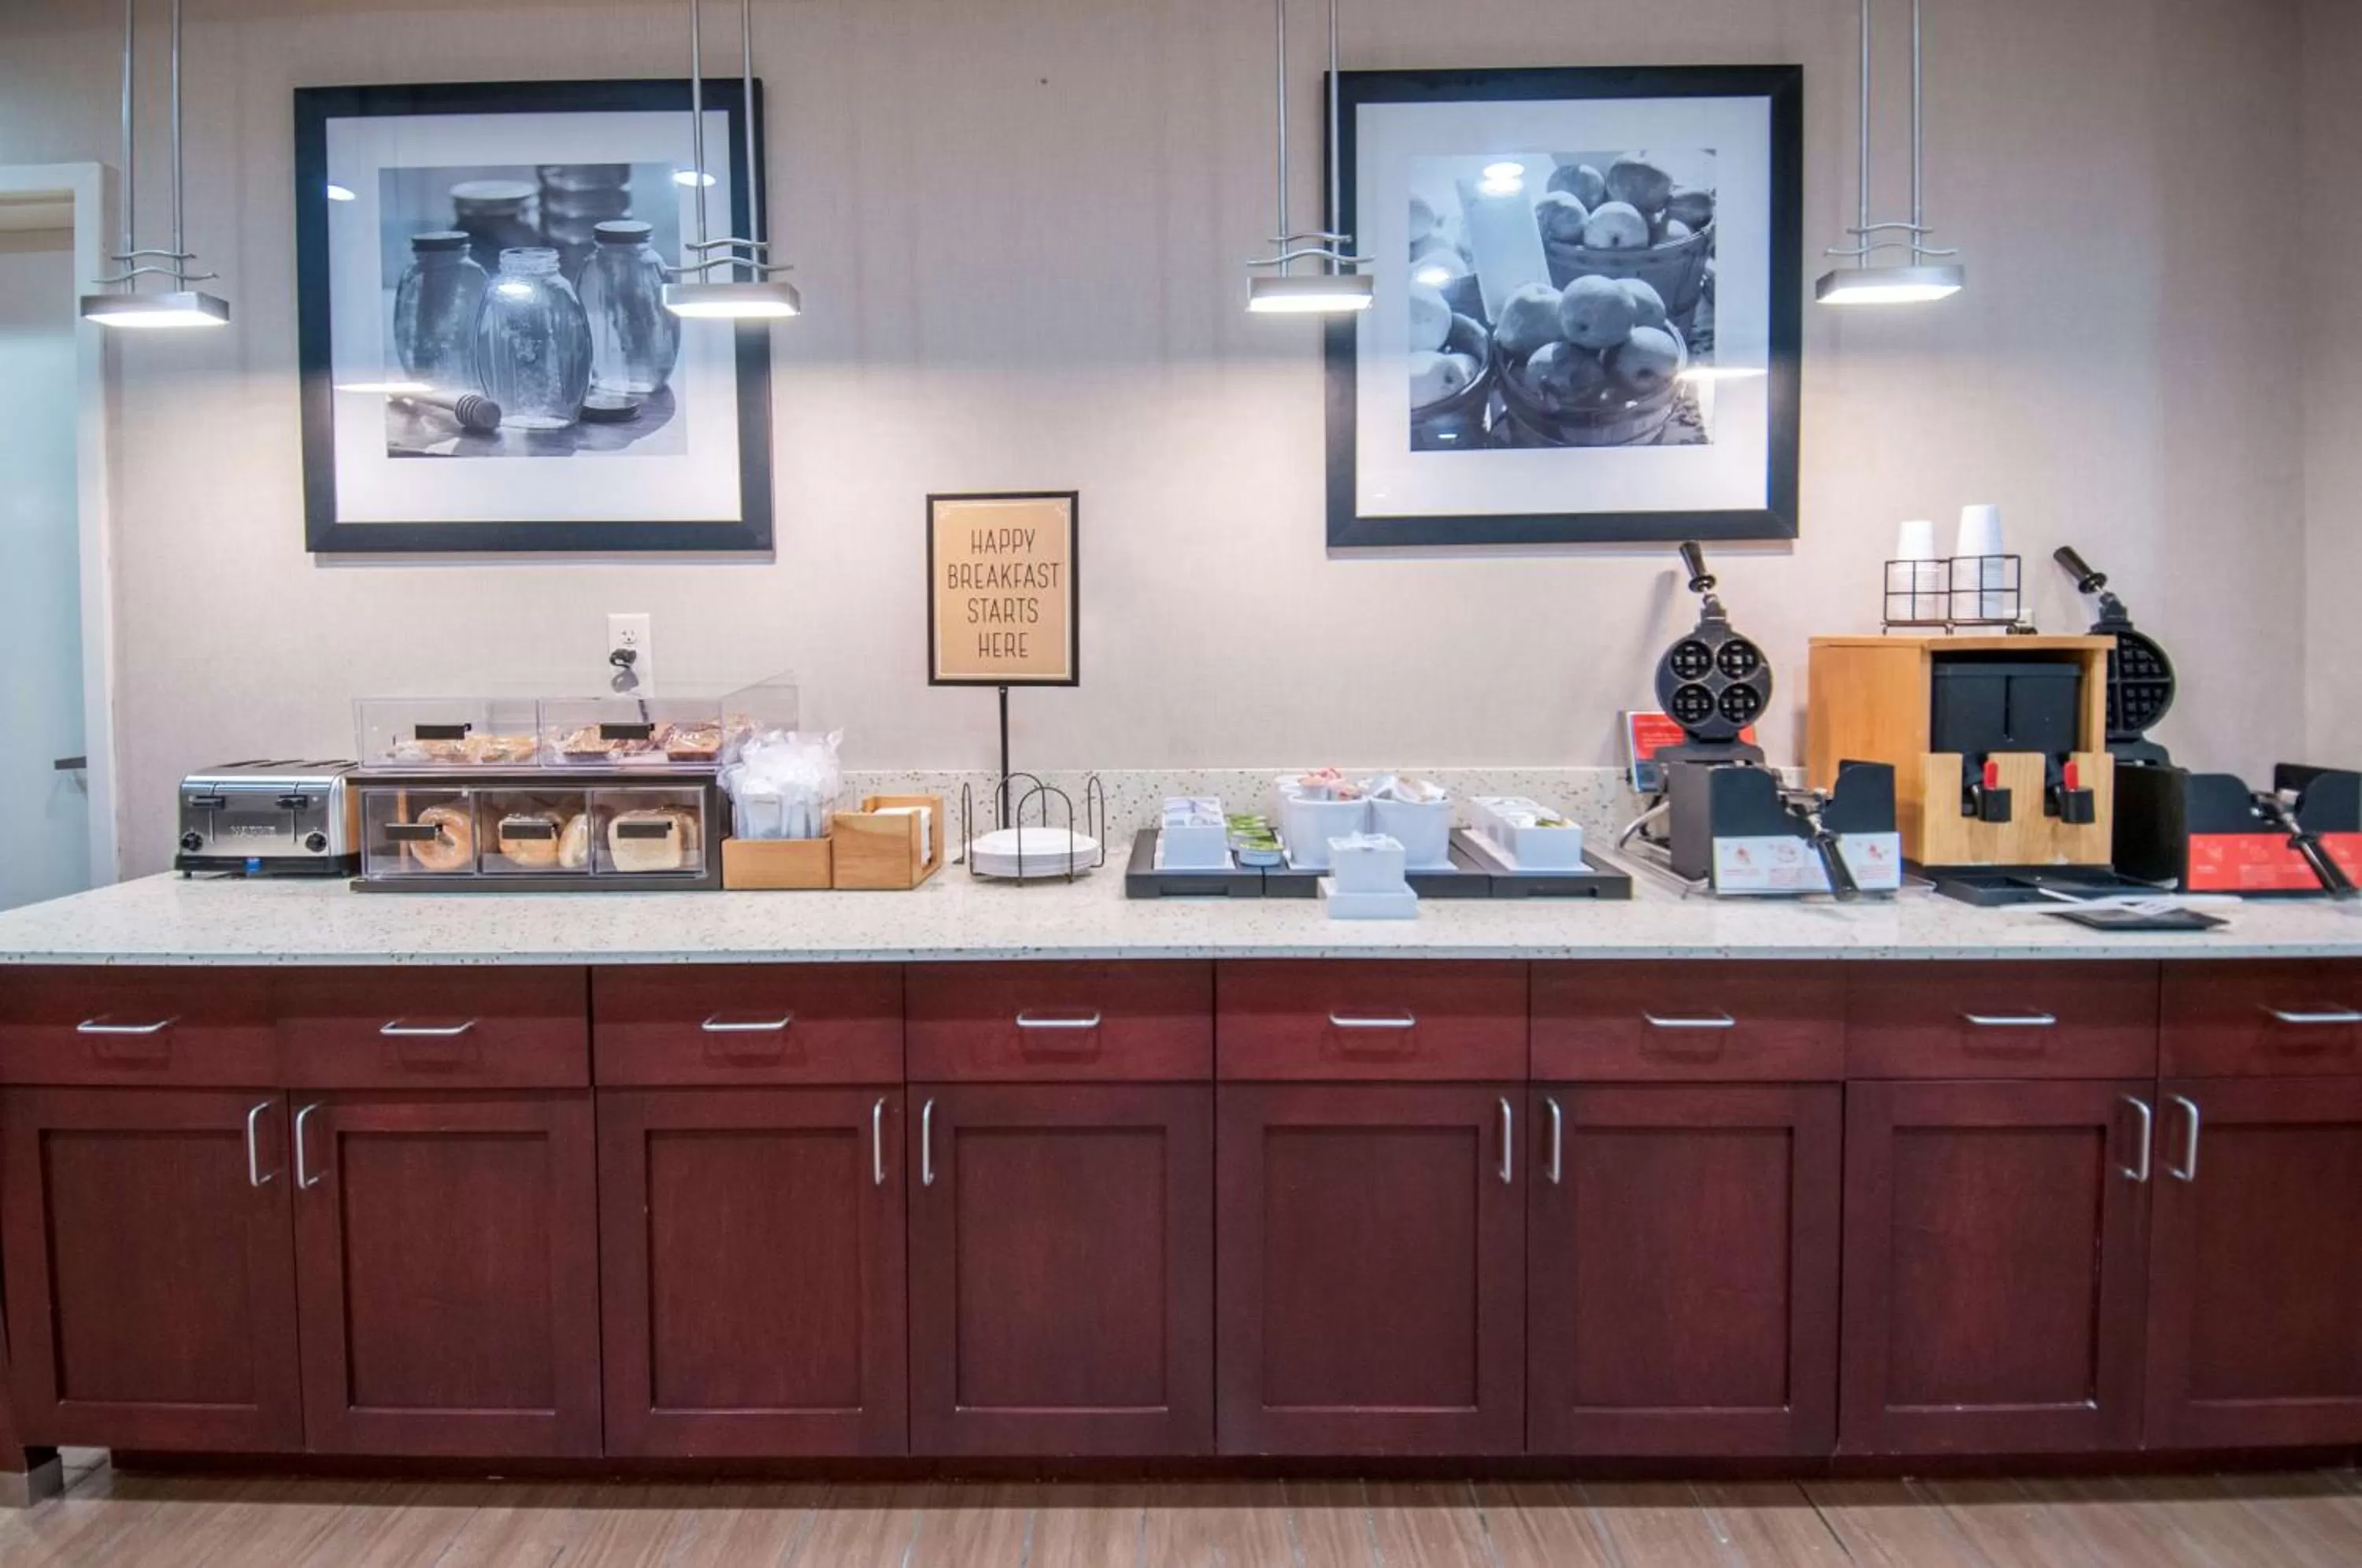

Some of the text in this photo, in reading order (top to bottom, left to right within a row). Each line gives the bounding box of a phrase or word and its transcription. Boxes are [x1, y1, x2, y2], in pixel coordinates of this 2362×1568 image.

[971, 528, 1035, 554] HAPPY
[947, 562, 1060, 590] BREAKFAST
[967, 597, 1038, 623] STARTS
[979, 631, 1028, 659] HERE
